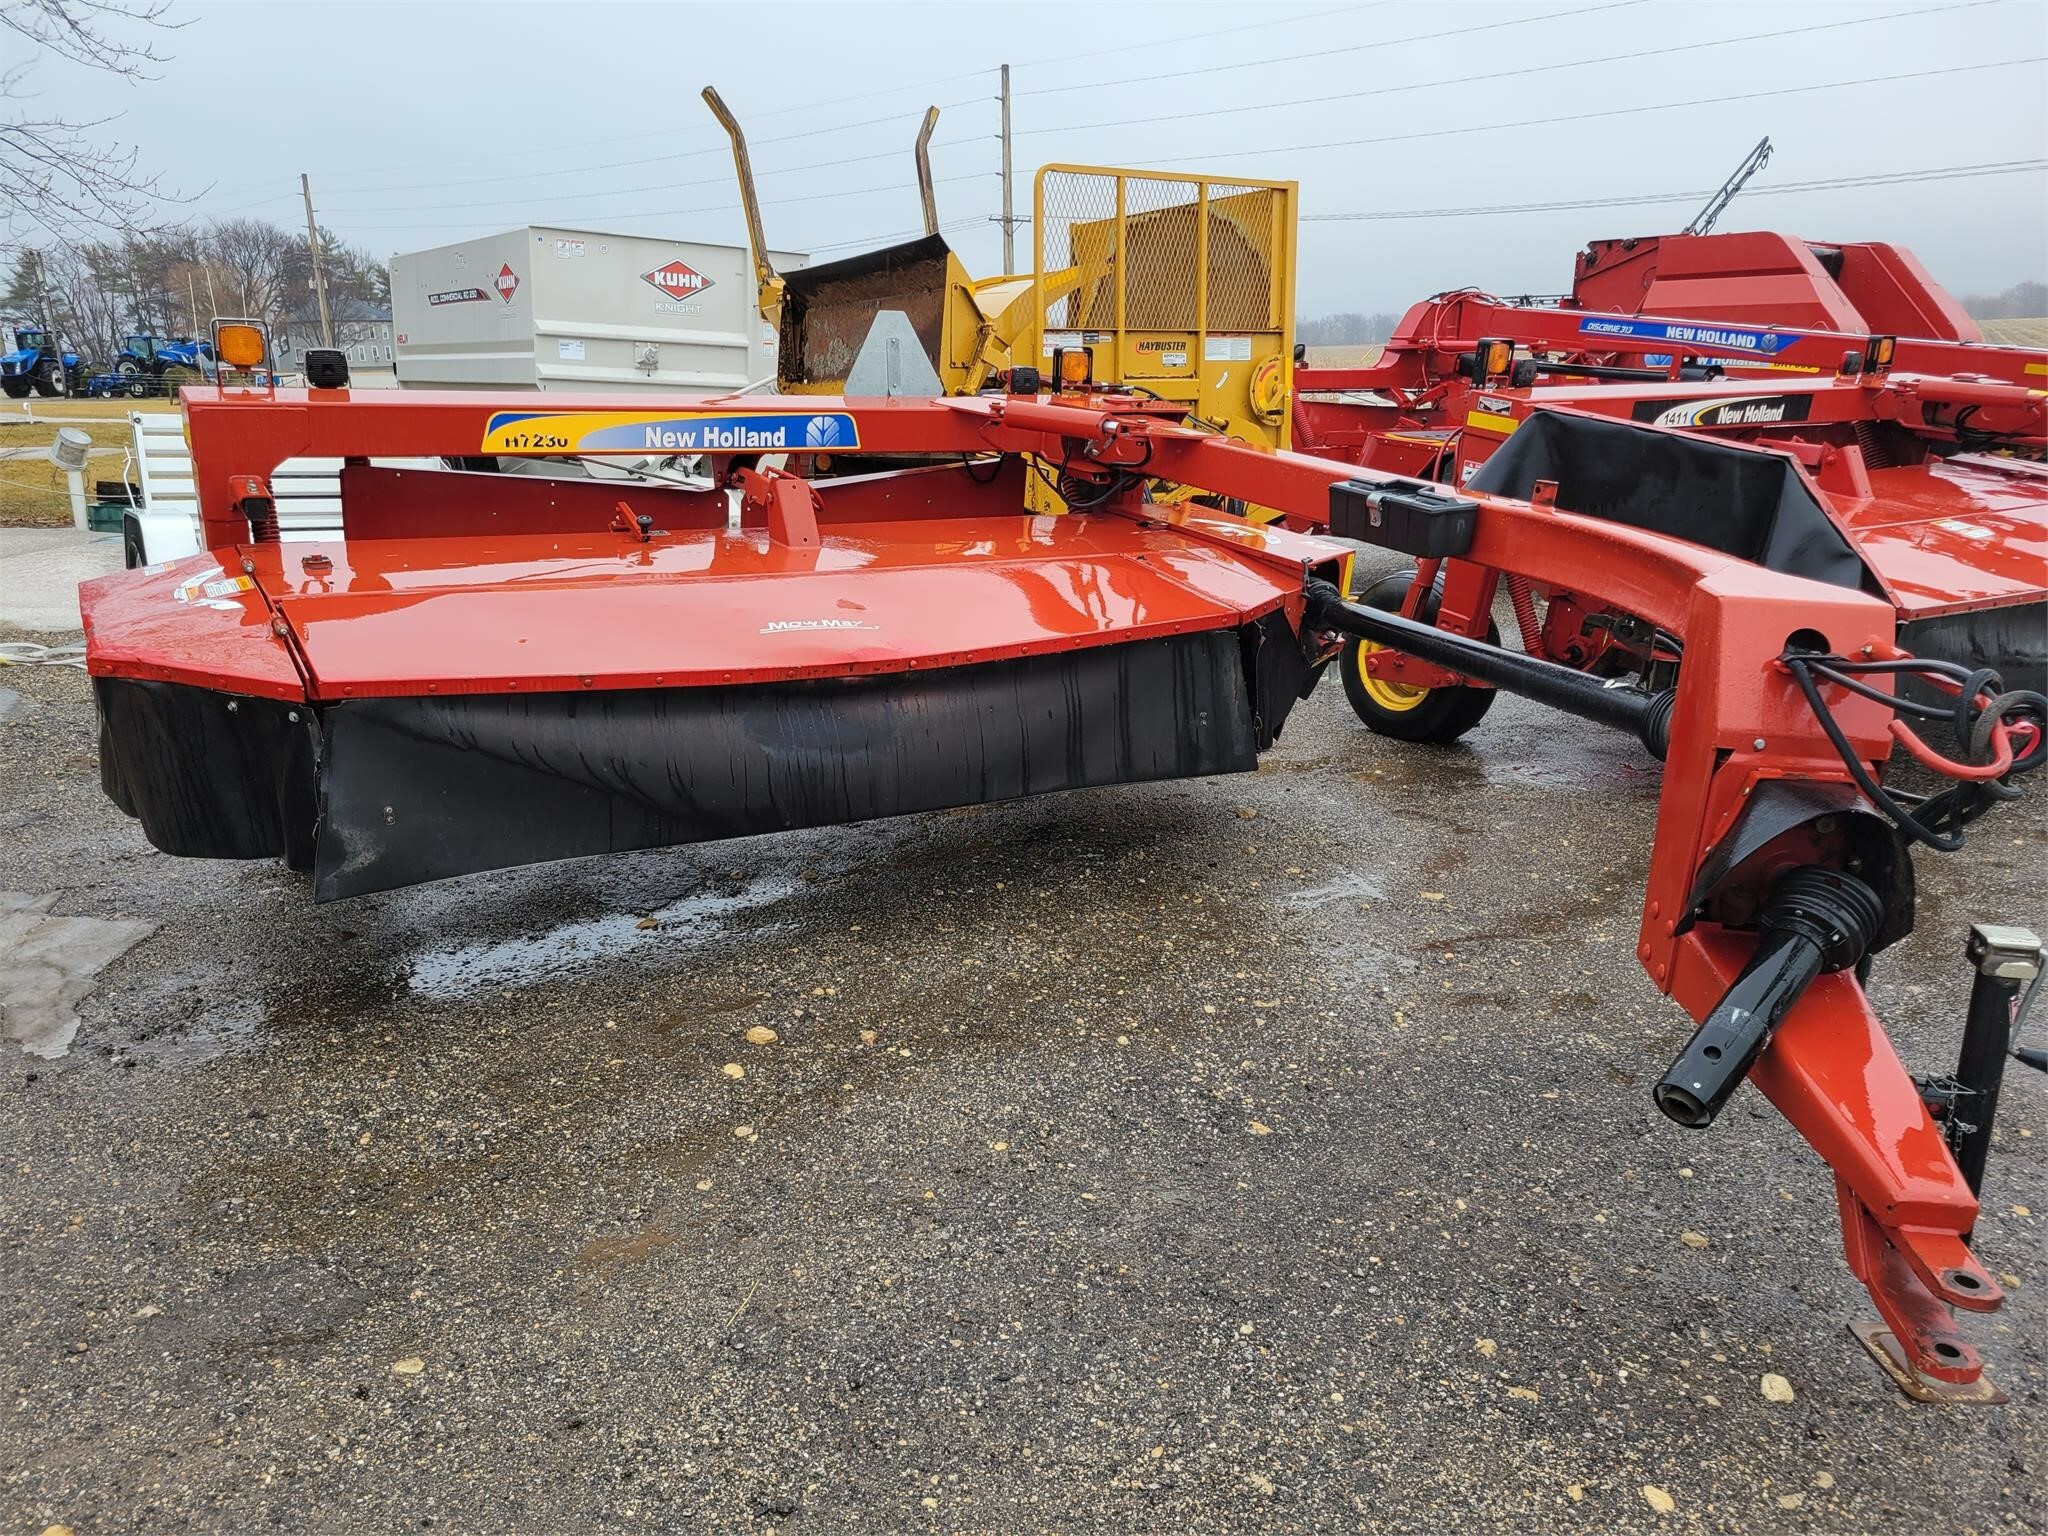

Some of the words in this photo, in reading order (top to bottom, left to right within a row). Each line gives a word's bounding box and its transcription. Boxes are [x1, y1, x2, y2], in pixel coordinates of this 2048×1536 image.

[498, 275, 516, 289] KUHN
[654, 271, 702, 288] KUHN
[655, 302, 704, 313] KNIGHT
[1586, 322, 1620, 333] DISCBINE
[1620, 325, 1634, 334] 313
[1665, 325, 1696, 341] NEW
[1696, 329, 1757, 348] HOLLAND
[1138, 341, 1187, 351] HAYBUSTER
[1664, 411, 1688, 425] 1411
[1716, 406, 1743, 425] New
[1743, 404, 1785, 423] Holland
[645, 426, 696, 448] New
[703, 426, 786, 447] Holland
